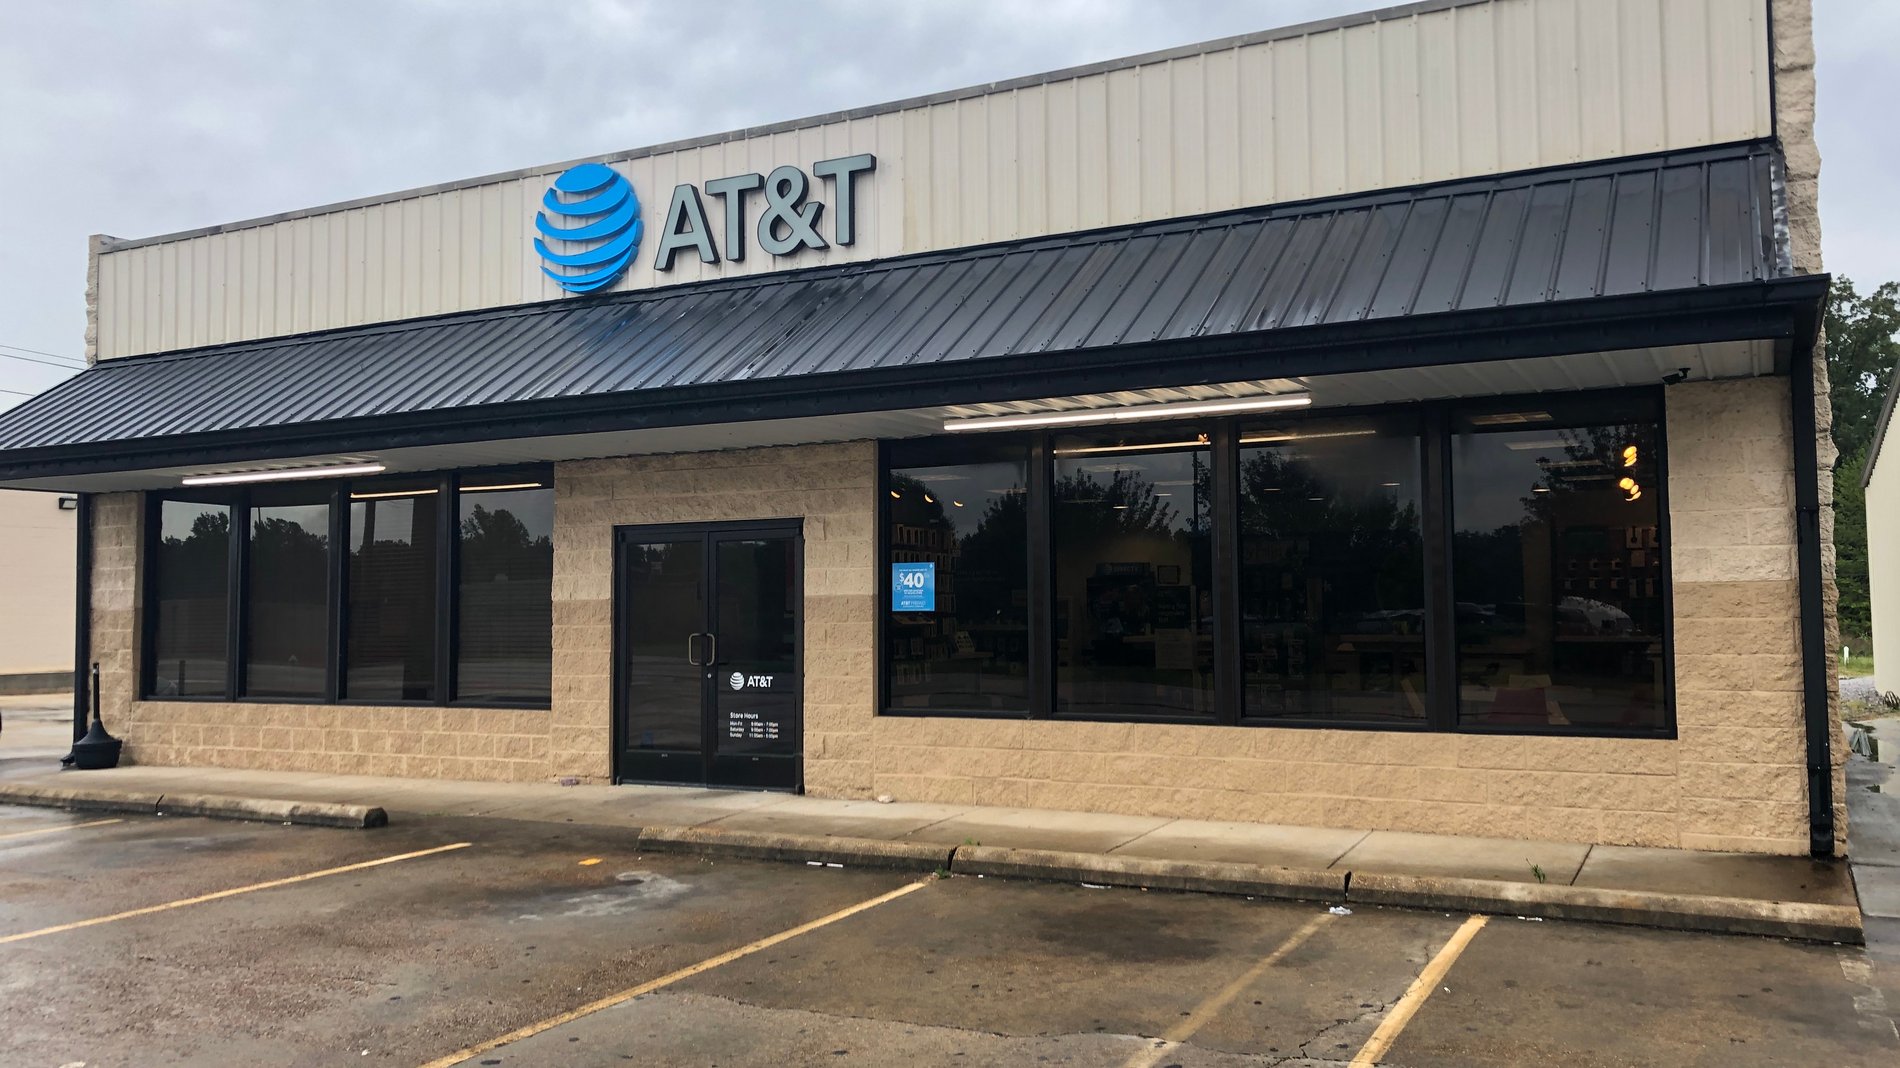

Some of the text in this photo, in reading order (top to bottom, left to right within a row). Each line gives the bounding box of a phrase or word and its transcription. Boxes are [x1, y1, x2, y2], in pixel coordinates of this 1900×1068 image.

[654, 153, 877, 272] AT&T
[899, 572, 924, 588] $40
[747, 676, 773, 687] AT&T
